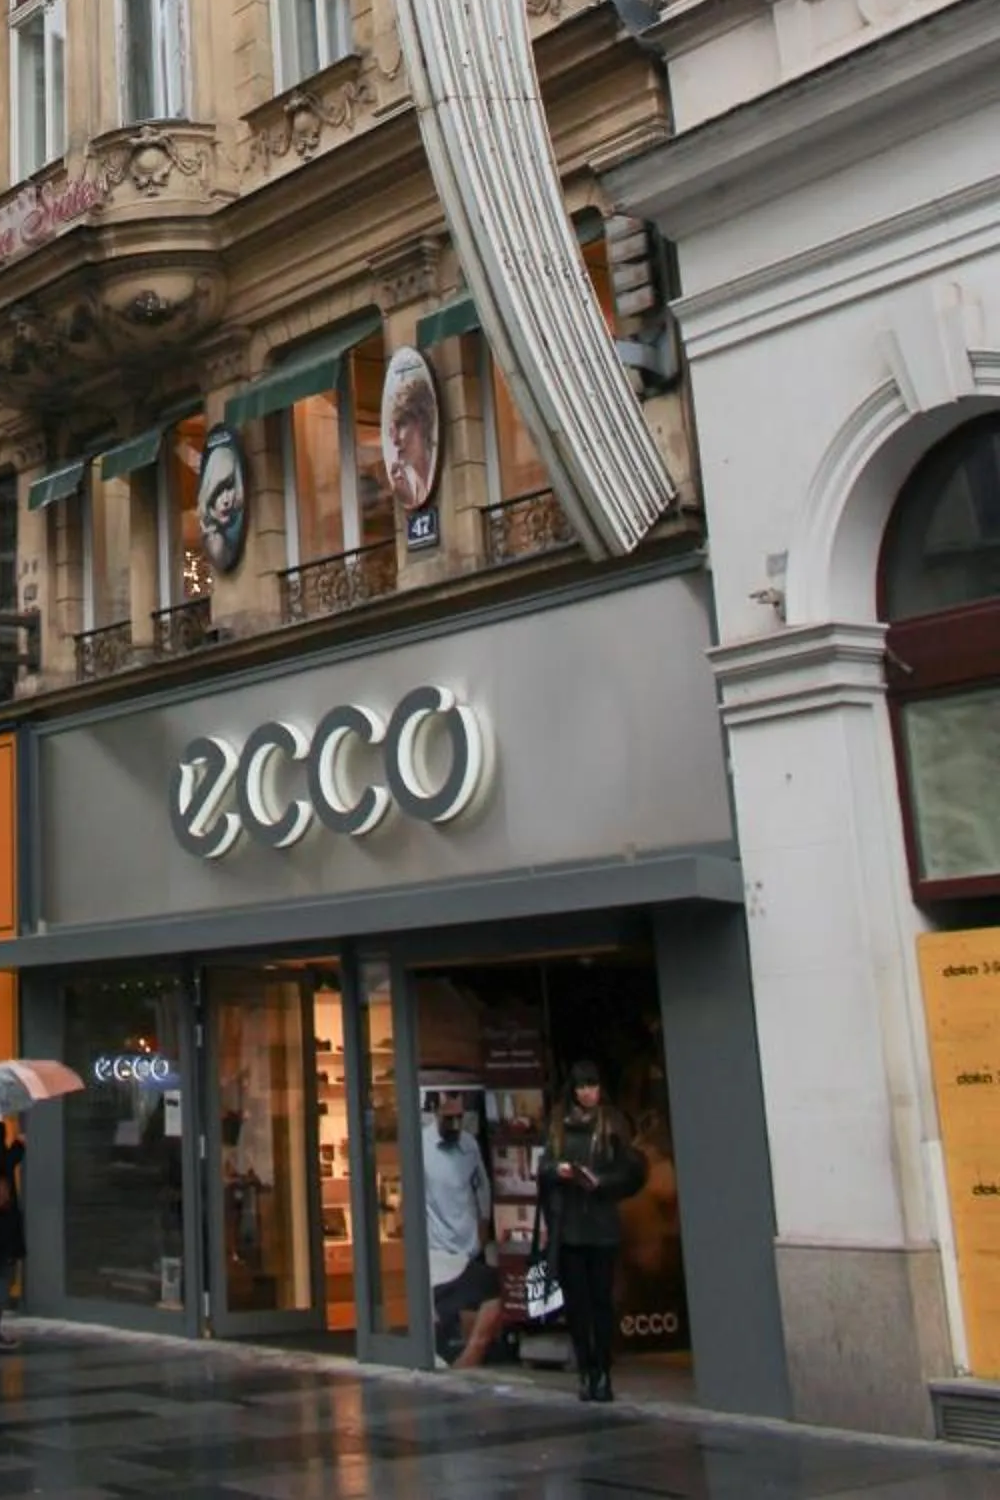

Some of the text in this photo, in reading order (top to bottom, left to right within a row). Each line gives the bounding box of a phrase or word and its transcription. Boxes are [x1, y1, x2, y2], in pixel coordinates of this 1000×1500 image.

[411, 515, 430, 536] 47
[171, 685, 480, 859] ecco
[95, 1056, 169, 1081] ecco
[620, 1313, 679, 1335] ecco
